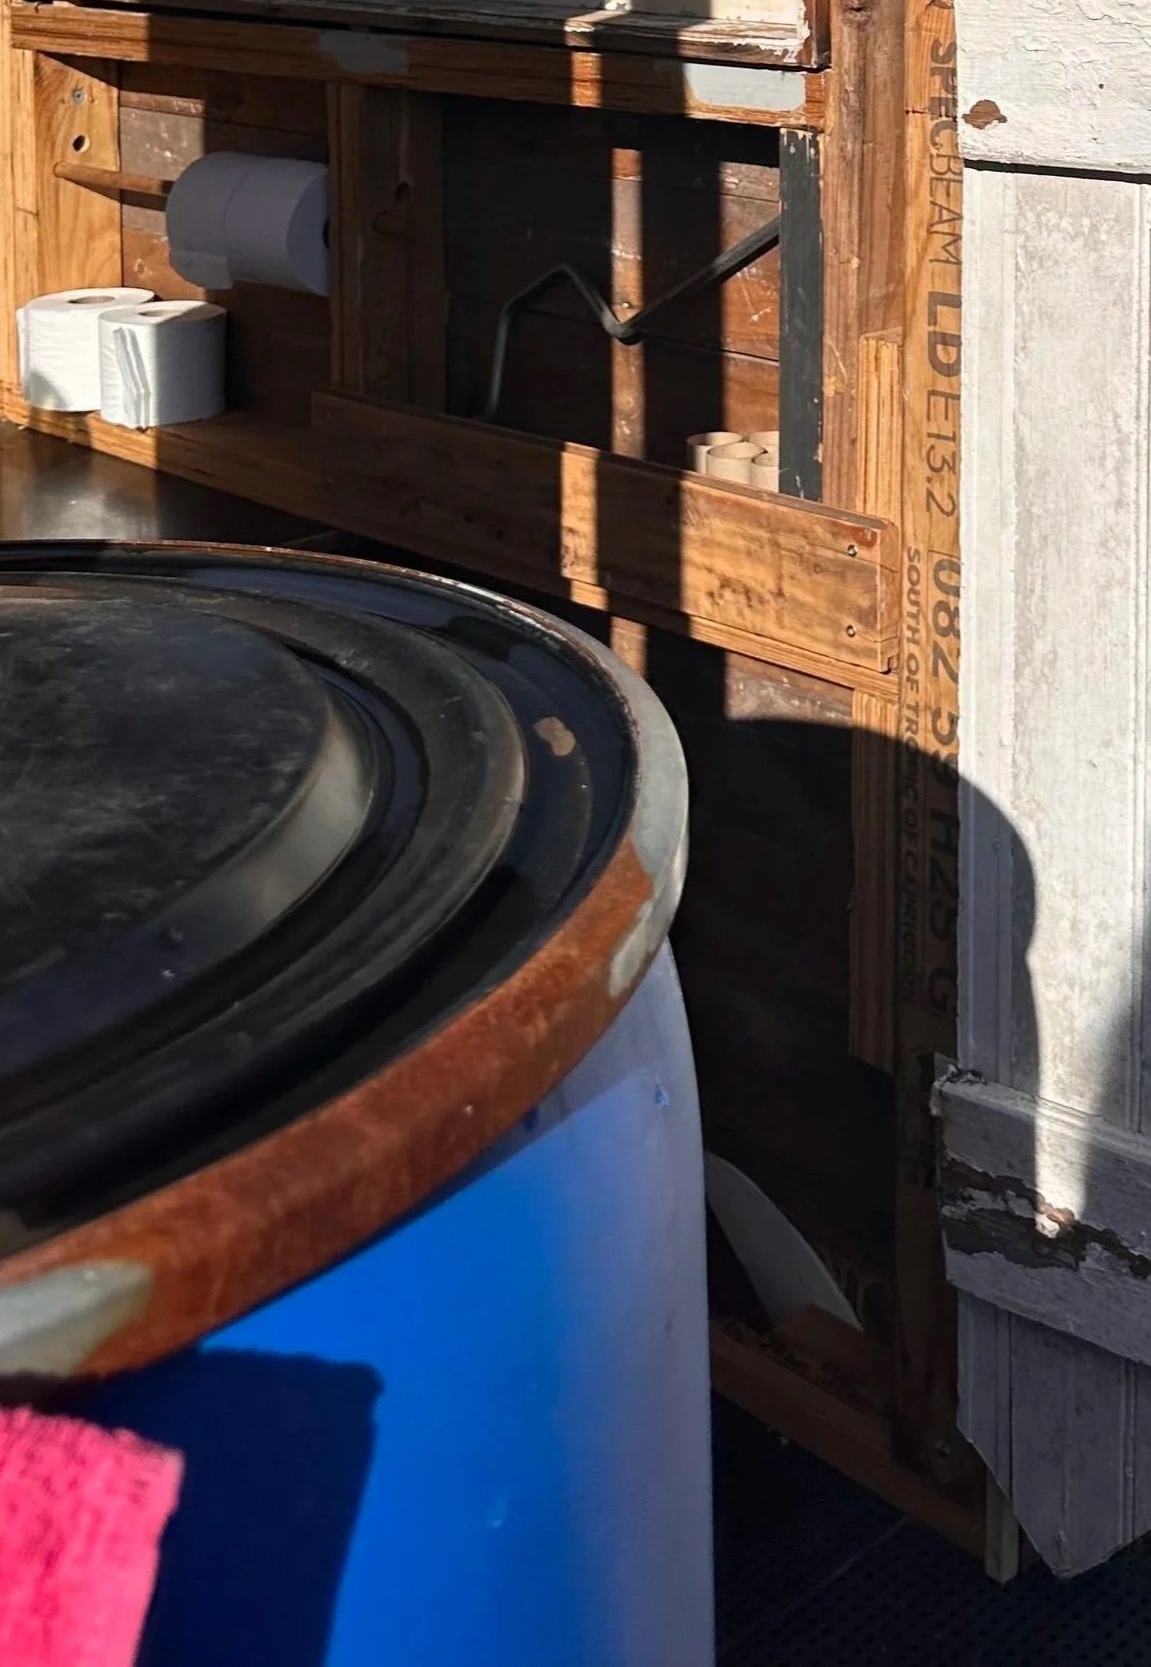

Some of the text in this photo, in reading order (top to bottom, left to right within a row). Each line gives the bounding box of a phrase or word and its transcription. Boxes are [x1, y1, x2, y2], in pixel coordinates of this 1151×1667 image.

[926, 291, 962, 377] LD
[924, 390, 962, 517] E13.2
[929, 556, 961, 680] 082
[902, 546, 922, 1006] SOUTH OF TROPIC OF CAPRICORN
